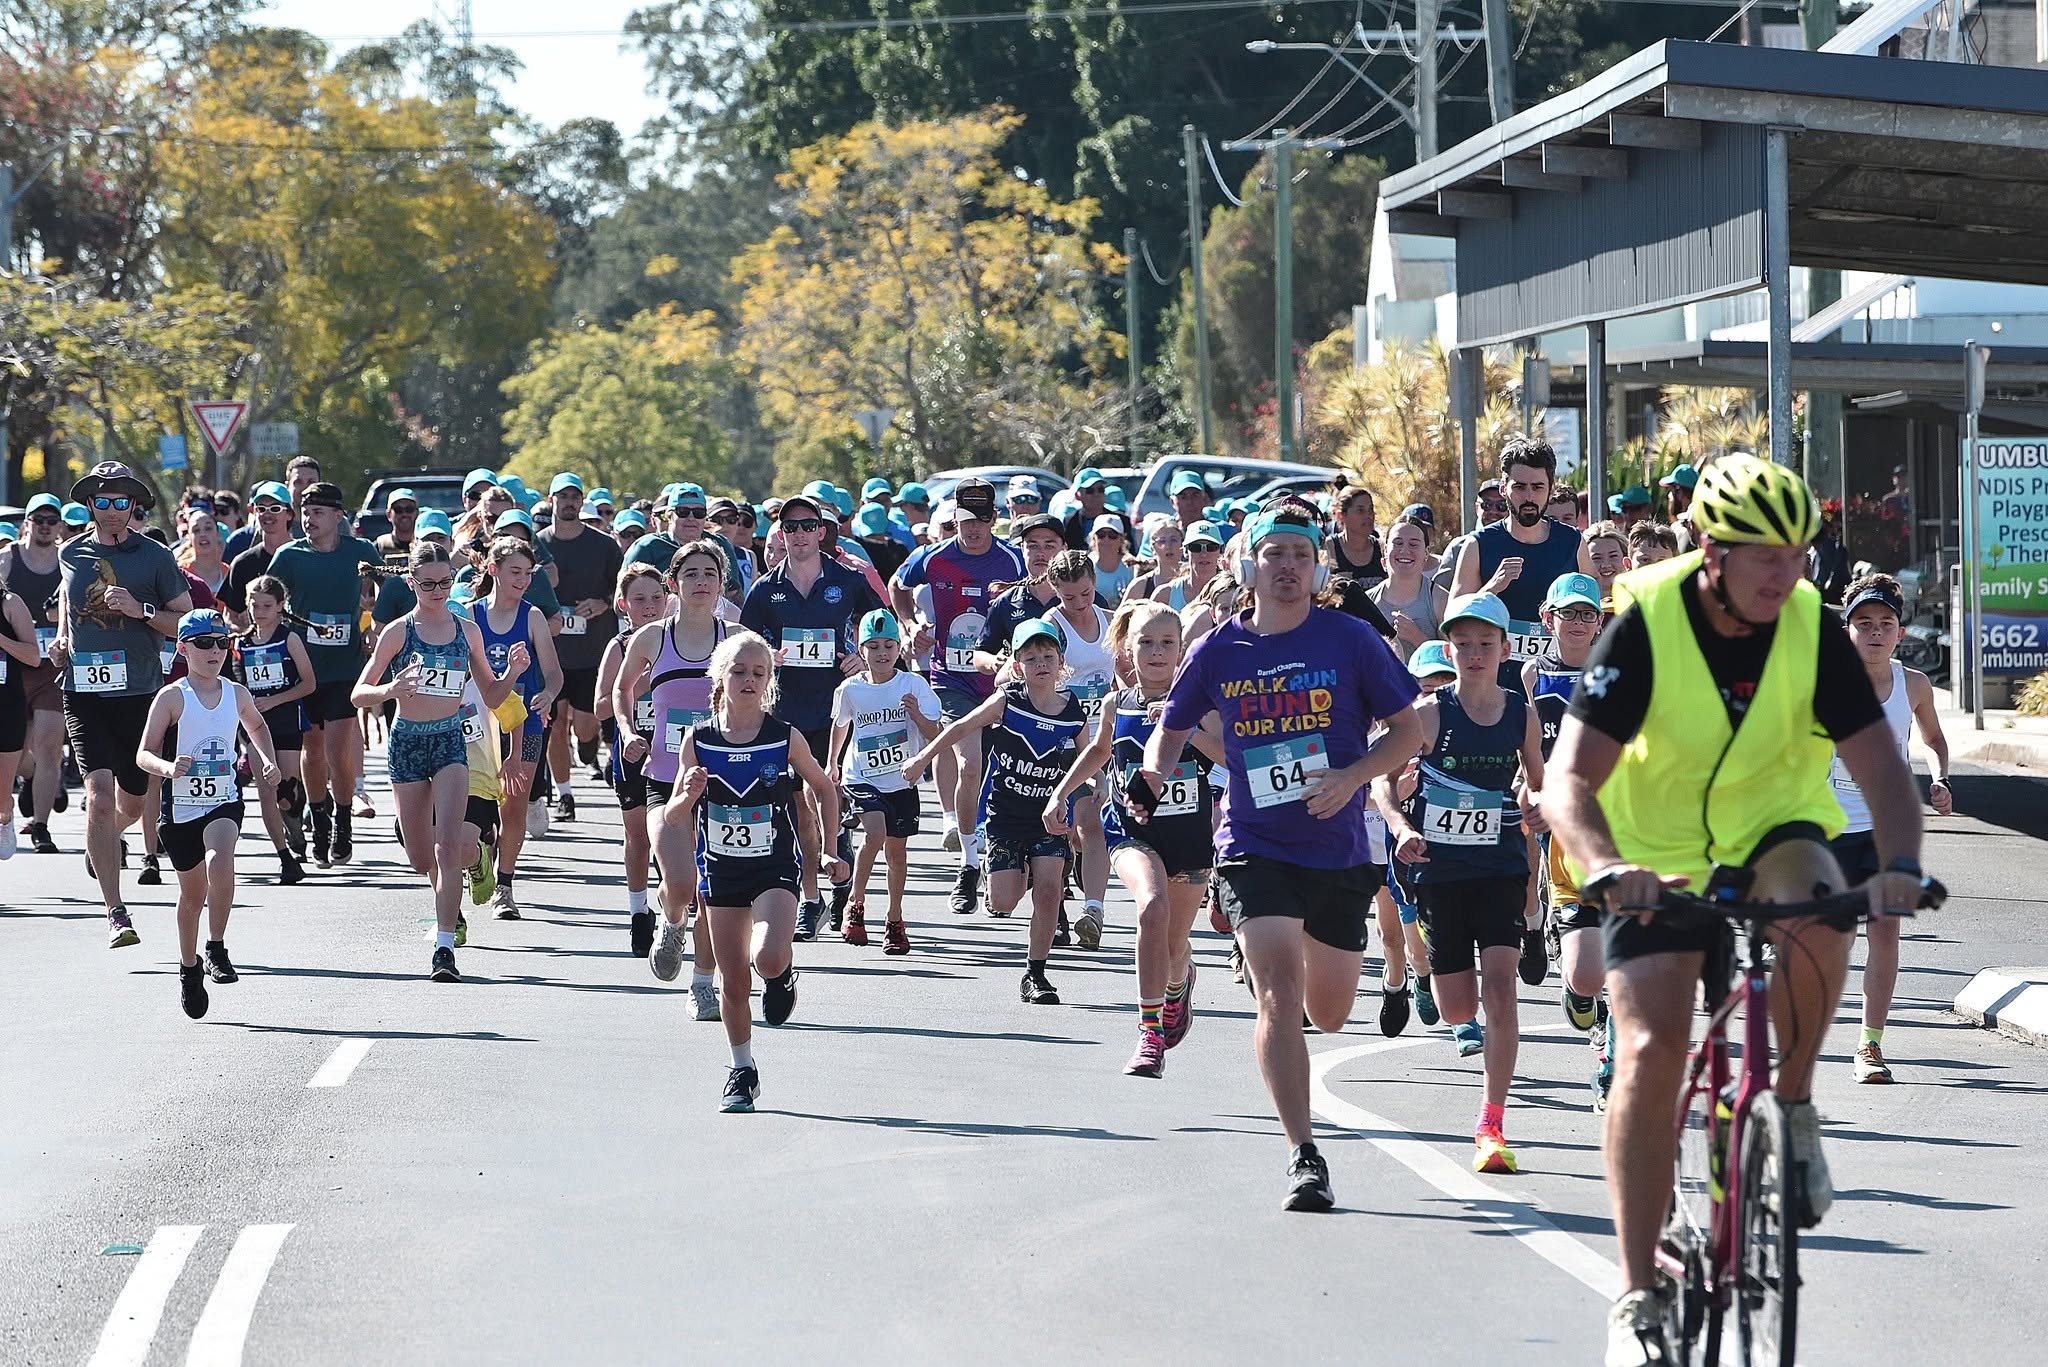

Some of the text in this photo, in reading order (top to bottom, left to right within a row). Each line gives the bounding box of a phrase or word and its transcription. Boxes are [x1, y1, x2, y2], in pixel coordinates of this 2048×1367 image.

[1978, 478, 2025, 495] NDIS
[1980, 577, 2032, 599] amily
[796, 643, 820, 659] 14
[1514, 635, 1552, 655] 157
[87, 666, 111, 684] 36
[252, 666, 270, 681] 84
[1277, 662, 1306, 672] Chapman
[425, 669, 449, 688] 21
[1220, 669, 1337, 699] WALK RUN
[1240, 688, 1333, 720] FUND
[410, 721, 449, 733] NIKE
[1035, 721, 1055, 732] ZBR
[1234, 712, 1332, 737] OUR KIDS
[1543, 722, 1557, 739] St
[727, 753, 752, 763] ZBR
[867, 746, 903, 768] 505
[1000, 752, 1014, 770] St
[1462, 755, 1503, 764] BYRON
[1269, 761, 1307, 792] 64
[189, 777, 217, 798] 35
[1004, 776, 1054, 798] Casino
[1159, 781, 1186, 804] 26
[1436, 810, 1488, 834] 478
[721, 825, 752, 847] 23
